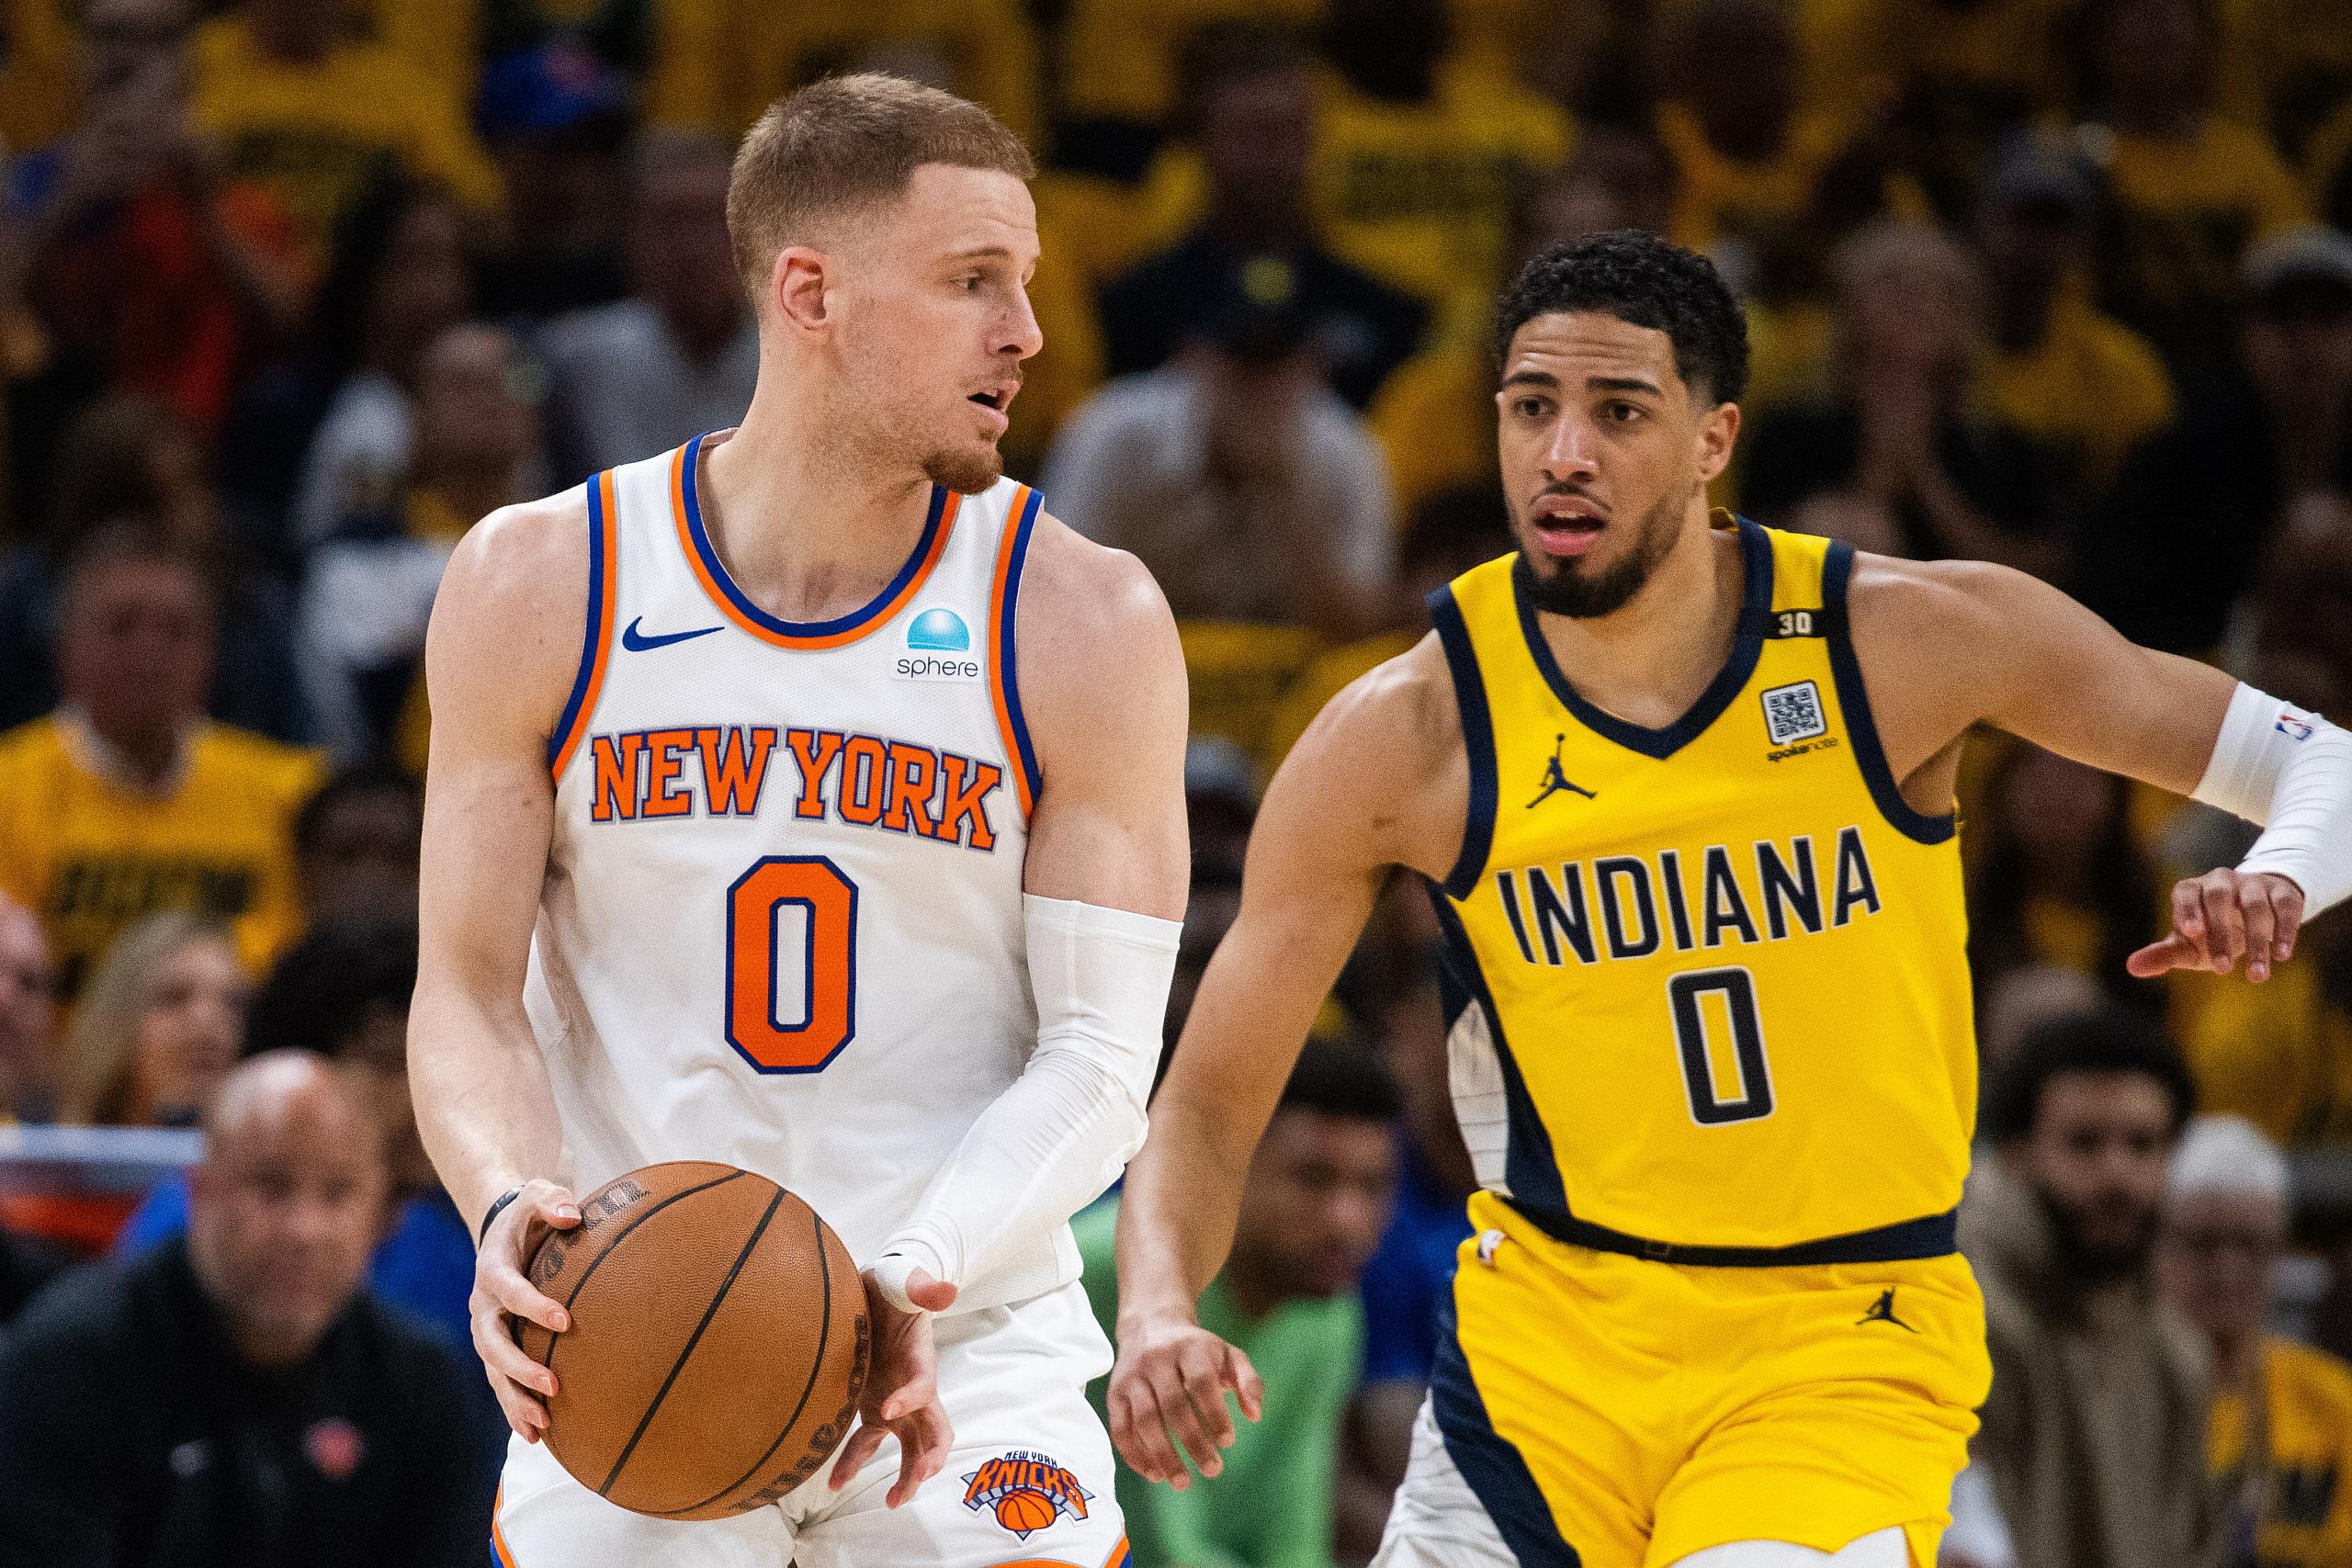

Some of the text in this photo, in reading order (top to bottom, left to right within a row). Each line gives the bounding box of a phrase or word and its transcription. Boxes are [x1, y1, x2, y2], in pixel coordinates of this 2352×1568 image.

[897, 656, 978, 678] sphere
[1778, 612, 1813, 637] 30
[591, 724, 1003, 854] NEW YORK
[1496, 824, 1882, 967] INDIANA
[724, 855, 859, 1075] 0
[1665, 964, 1776, 1128] 0
[963, 1457, 1089, 1521] KNICKS
[1003, 1450, 1057, 1467] NEW YORK
